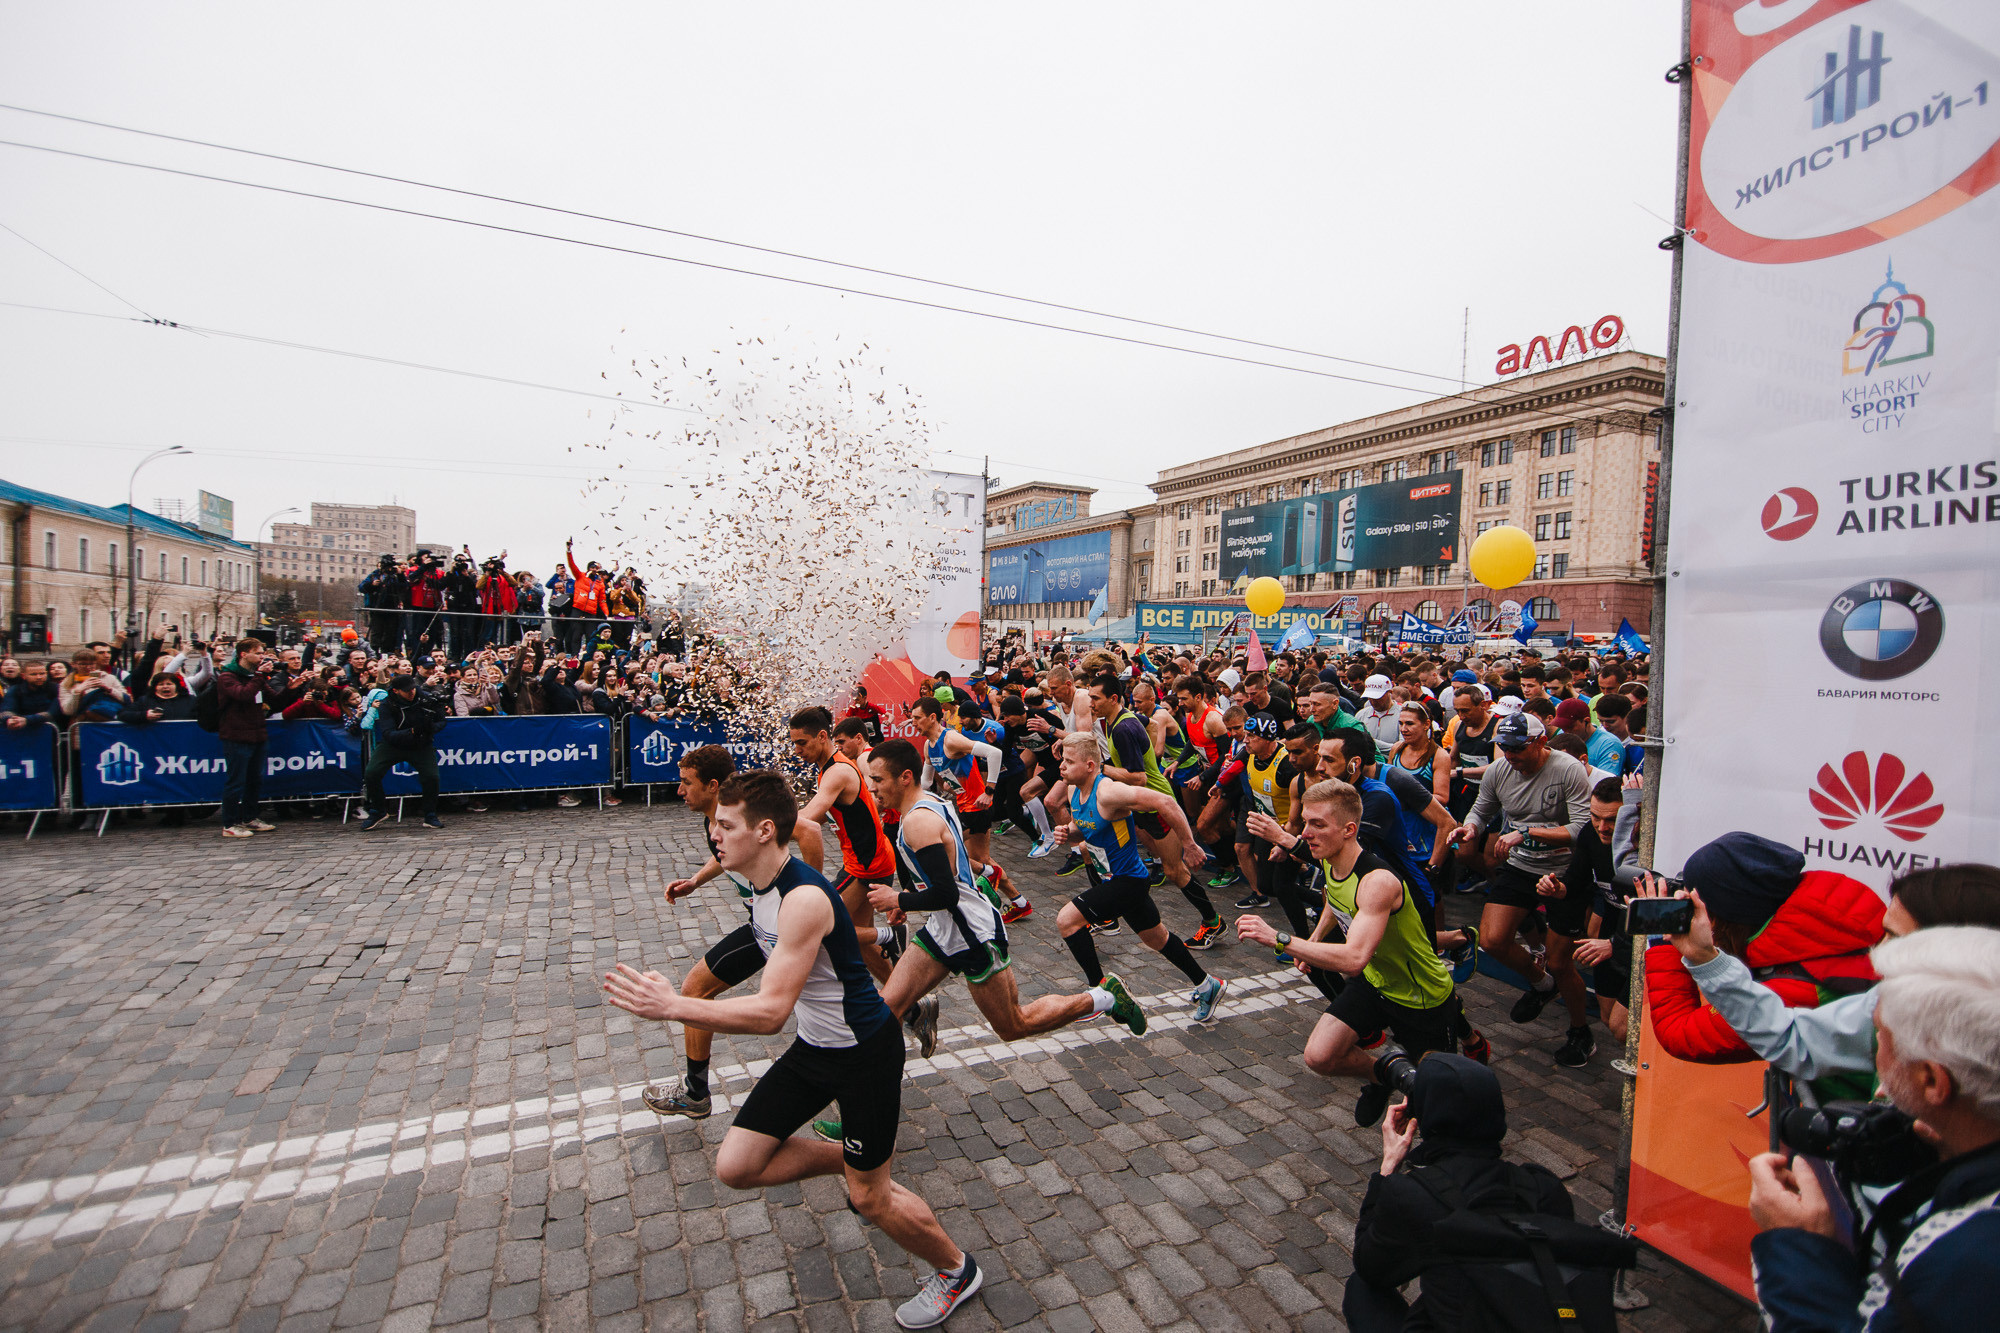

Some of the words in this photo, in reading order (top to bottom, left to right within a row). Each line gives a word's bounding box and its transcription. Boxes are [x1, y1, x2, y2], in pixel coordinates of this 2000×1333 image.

[1735, 80, 1988, 209] ЖИЛСТРОЙ-1
[1842, 372, 1931, 403] KHARKIV
[1851, 393, 1920, 419] SPORT
[1863, 412, 1906, 433] CITY
[1411, 485, 1450, 498] ЦИТРУС
[1839, 460, 1998, 504] TURKIS
[1015, 493, 1078, 531] MEIZU
[1228, 516, 1255, 527] SAMSUNG
[1342, 499, 1356, 550] S10+
[1366, 526, 1393, 536] Galaxy
[1393, 523, 1411, 534] S10e
[1415, 521, 1428, 531] S10
[1432, 519, 1450, 529] S10+
[1227, 532, 1273, 547] Випереджай
[1232, 548, 1267, 559] майбутнє
[1833, 581, 1934, 616] BMW
[1142, 609, 1185, 627] ВСЕ
[1190, 610, 1234, 630] ДЛЯ
[1401, 631, 1442, 642] ВМЕСТЕ
[1444, 633, 1450, 642] К
[1817, 689, 1877, 700] БАВАРИЯ
[1880, 690, 1940, 702] МОТОРС
[155, 751, 347, 776] Жилрой-1
[437, 744, 598, 767] Жилстрой-1
